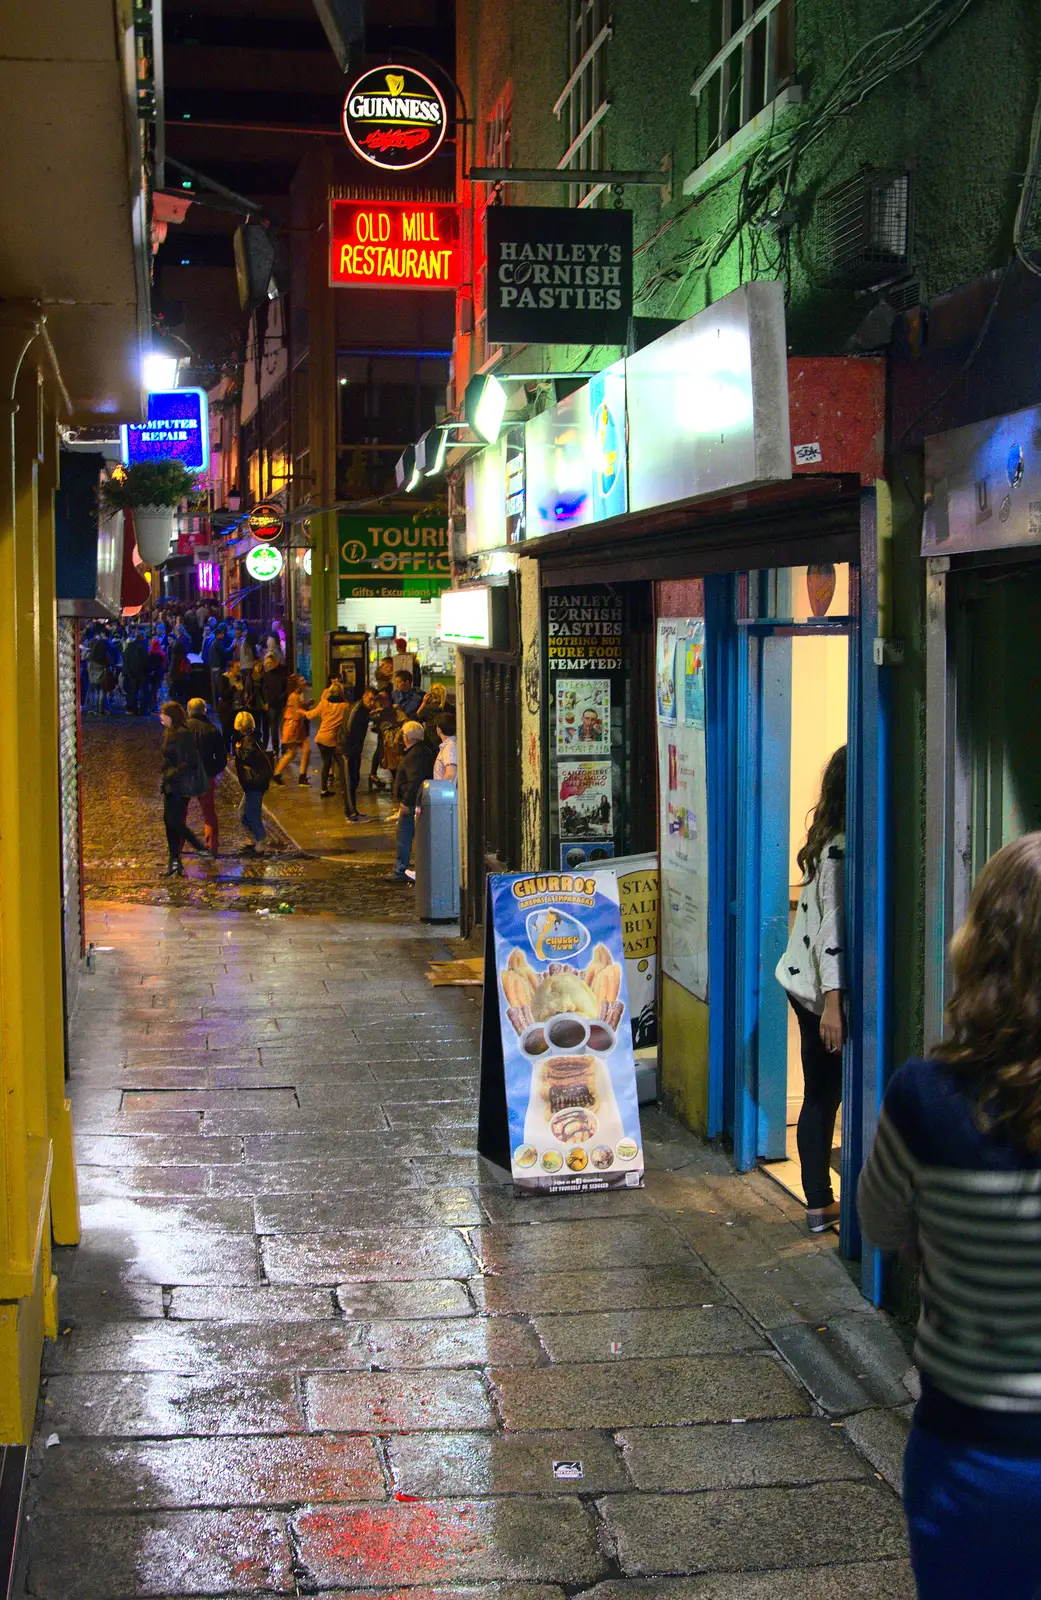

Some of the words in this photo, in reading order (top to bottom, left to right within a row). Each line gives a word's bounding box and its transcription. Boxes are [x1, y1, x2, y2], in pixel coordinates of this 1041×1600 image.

[349, 96, 440, 122] GUINNESS
[356, 212, 391, 242] OLD
[402, 212, 439, 242] MILL
[500, 242, 622, 263] HANLEY'S
[340, 244, 452, 280] RESTAURANT
[499, 261, 621, 286] CORNISH
[500, 287, 622, 310] PASTIES
[141, 431, 188, 441] REPAIR
[352, 587, 374, 597] Gifts
[381, 587, 430, 597] Excursions
[548, 595, 622, 607] HANLEY'S
[548, 622, 622, 635] PASTIES
[548, 637, 597, 645] NOTHING
[548, 647, 585, 657] PURE
[549, 659, 622, 669] TEMPTED?
[513, 875, 596, 897] CHURROS
[622, 879, 659, 895] STAY
[625, 917, 656, 933] BUY
